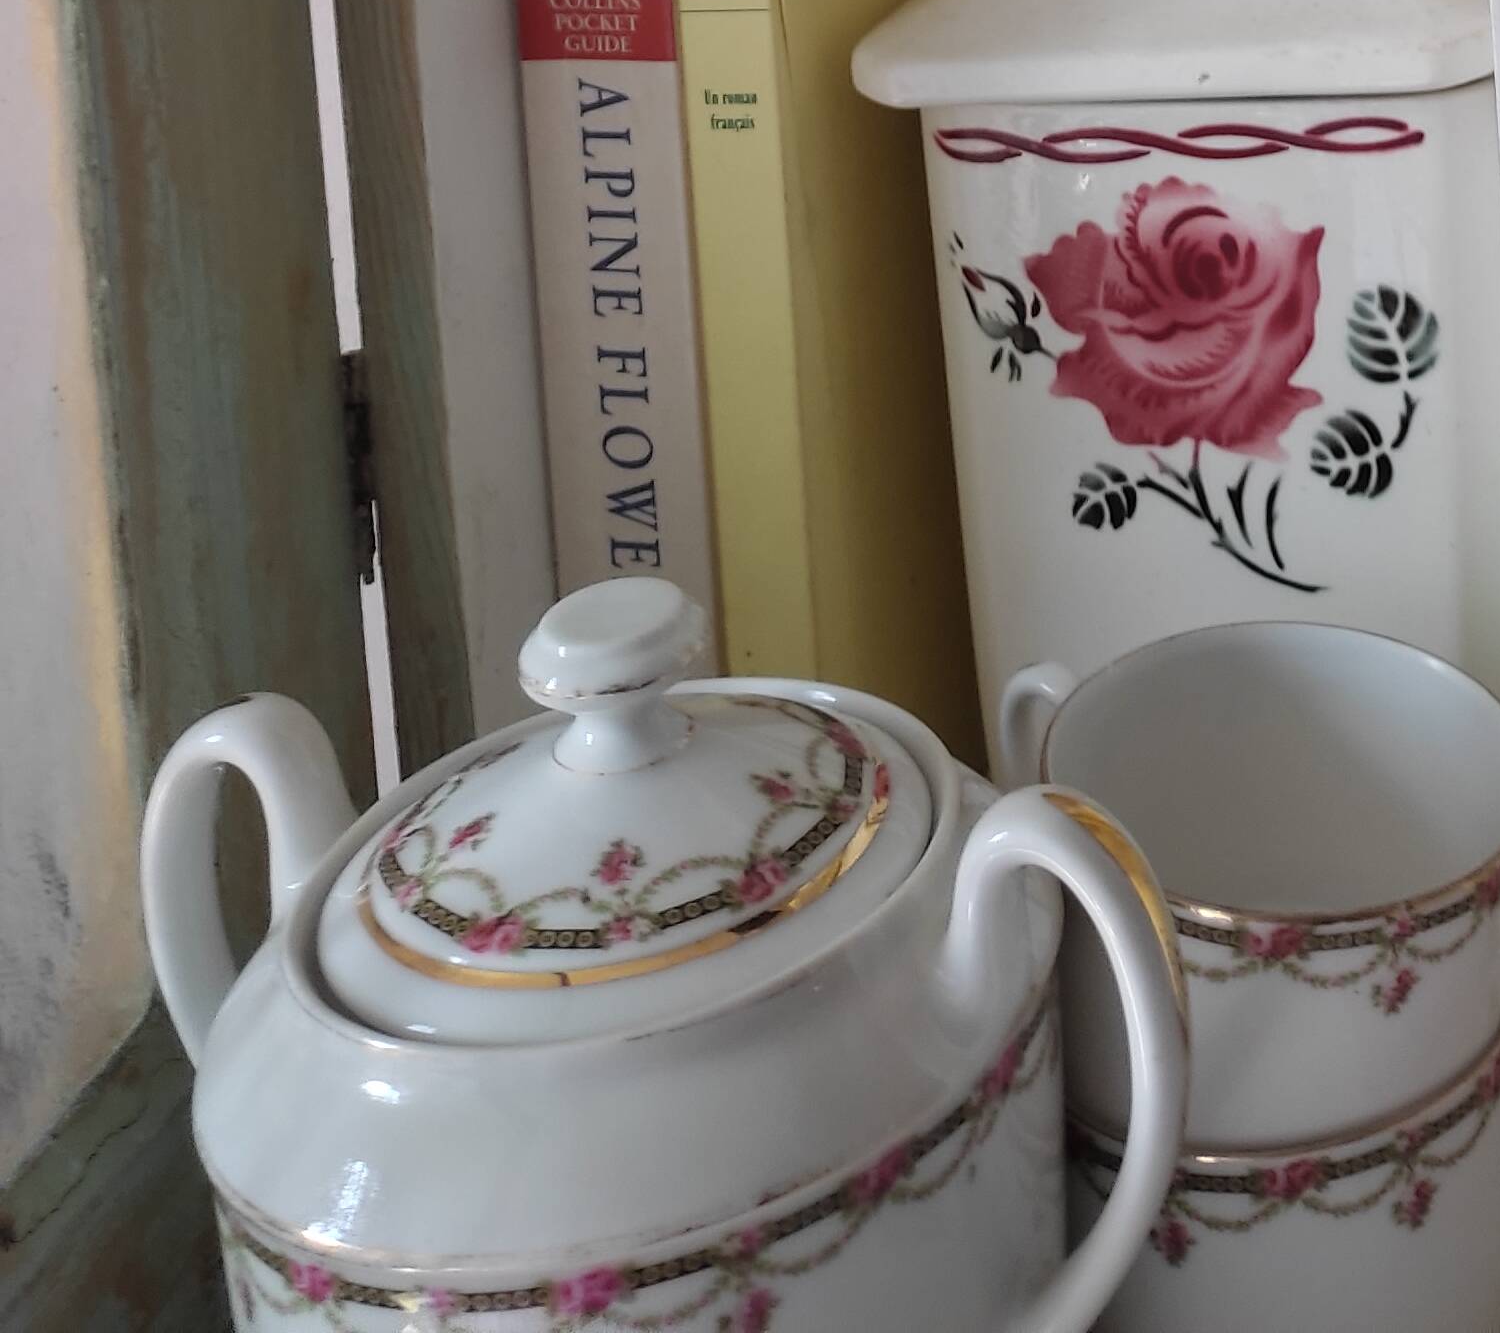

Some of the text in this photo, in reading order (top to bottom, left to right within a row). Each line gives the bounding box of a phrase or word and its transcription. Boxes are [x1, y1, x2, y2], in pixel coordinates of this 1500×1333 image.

[555, 13, 638, 32] POCKET
[564, 35, 632, 53] GUIDE
[704, 88, 757, 105] Un roman
[711, 113, 754, 132] français
[577, 77, 661, 569] ALPINE FLOWE
